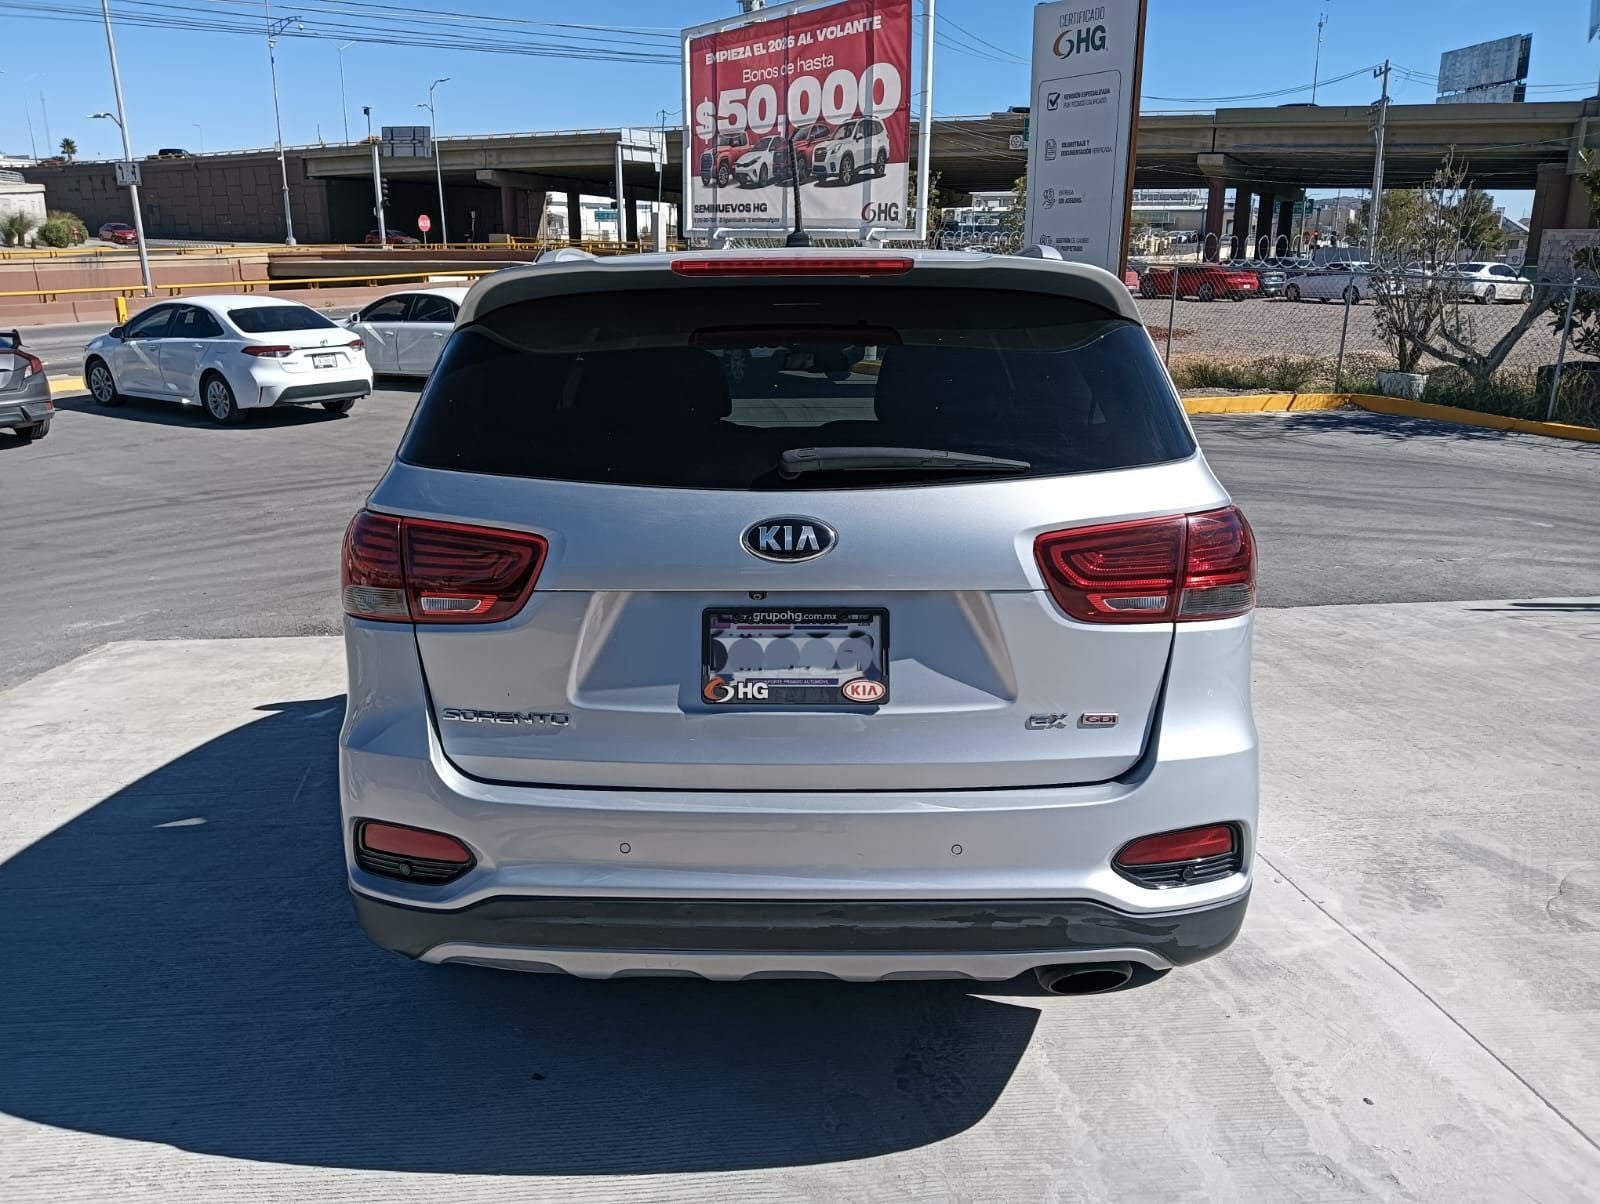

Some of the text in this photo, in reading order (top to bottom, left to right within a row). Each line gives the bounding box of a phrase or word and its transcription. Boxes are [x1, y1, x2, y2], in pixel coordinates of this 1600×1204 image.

[1060, 7, 1105, 27] CERTIFICADO
[705, 15, 882, 65] EMPIEZA EL 2026 AL VOLANTE
[1075, 24, 1106, 54] HG
[743, 53, 834, 84] Bonos de hasta
[695, 62, 902, 144] $50,000
[694, 202, 768, 214] SEMINUEVOS HG
[877, 202, 899, 222] HG
[758, 525, 820, 551] KIA
[737, 681, 769, 699] HG
[850, 684, 878, 696] KIA
[442, 707, 569, 726] SORENTO
[1027, 713, 1068, 728] EX
